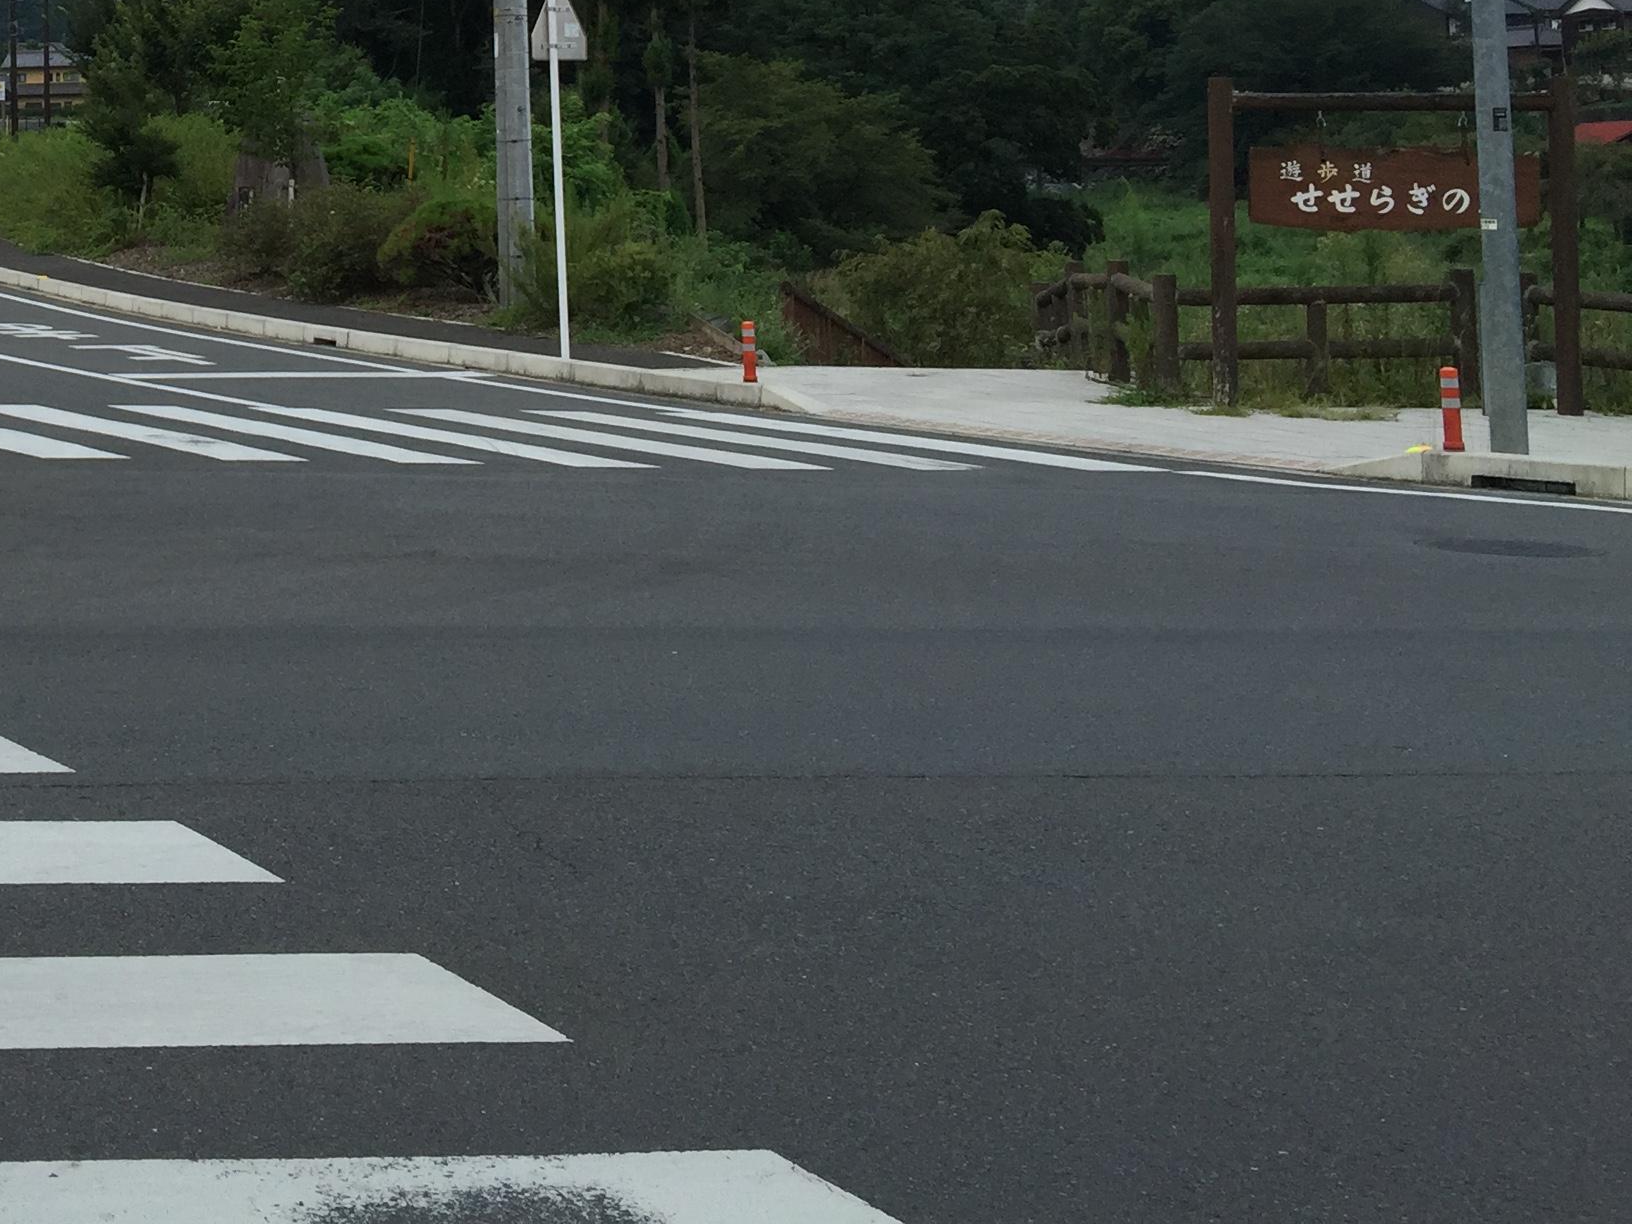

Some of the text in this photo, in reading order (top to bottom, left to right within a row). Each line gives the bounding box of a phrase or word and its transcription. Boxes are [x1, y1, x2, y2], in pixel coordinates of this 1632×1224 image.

[1280, 160, 1372, 183] 遊歩道
[1290, 183, 1482, 214] せせらぎの
